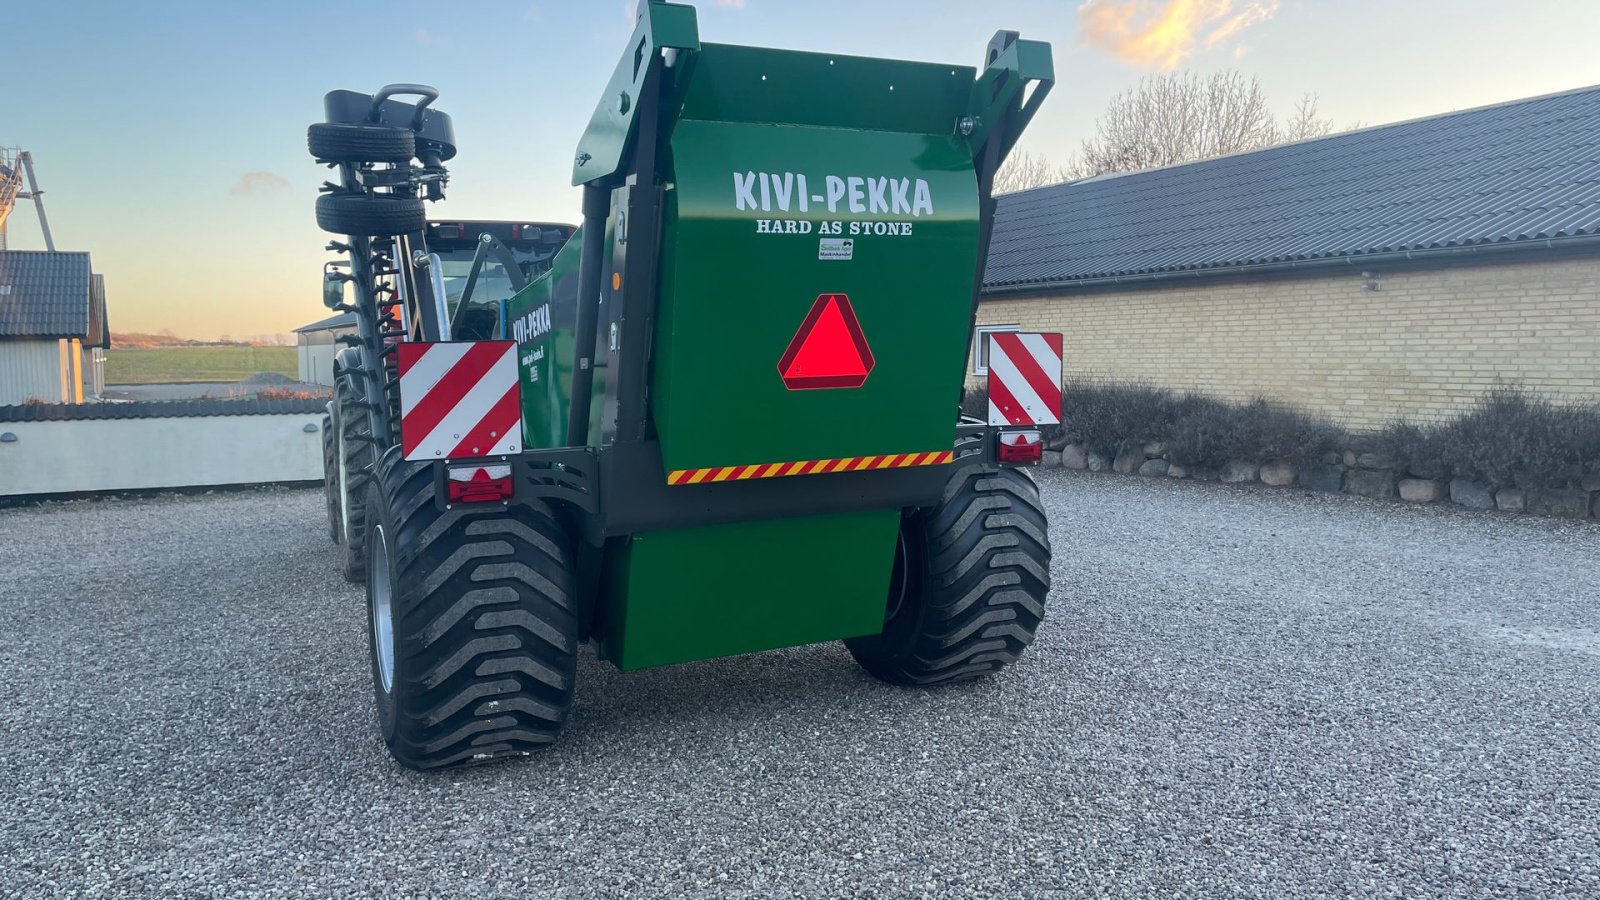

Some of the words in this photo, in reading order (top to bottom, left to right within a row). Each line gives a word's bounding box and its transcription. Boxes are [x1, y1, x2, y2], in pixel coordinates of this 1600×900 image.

[733, 171, 933, 217] KIVI-PEKKA
[756, 219, 812, 234] HARD
[818, 220, 842, 235] AS
[849, 221, 912, 236] STONE
[513, 304, 551, 345] KIVI-PEKKA
